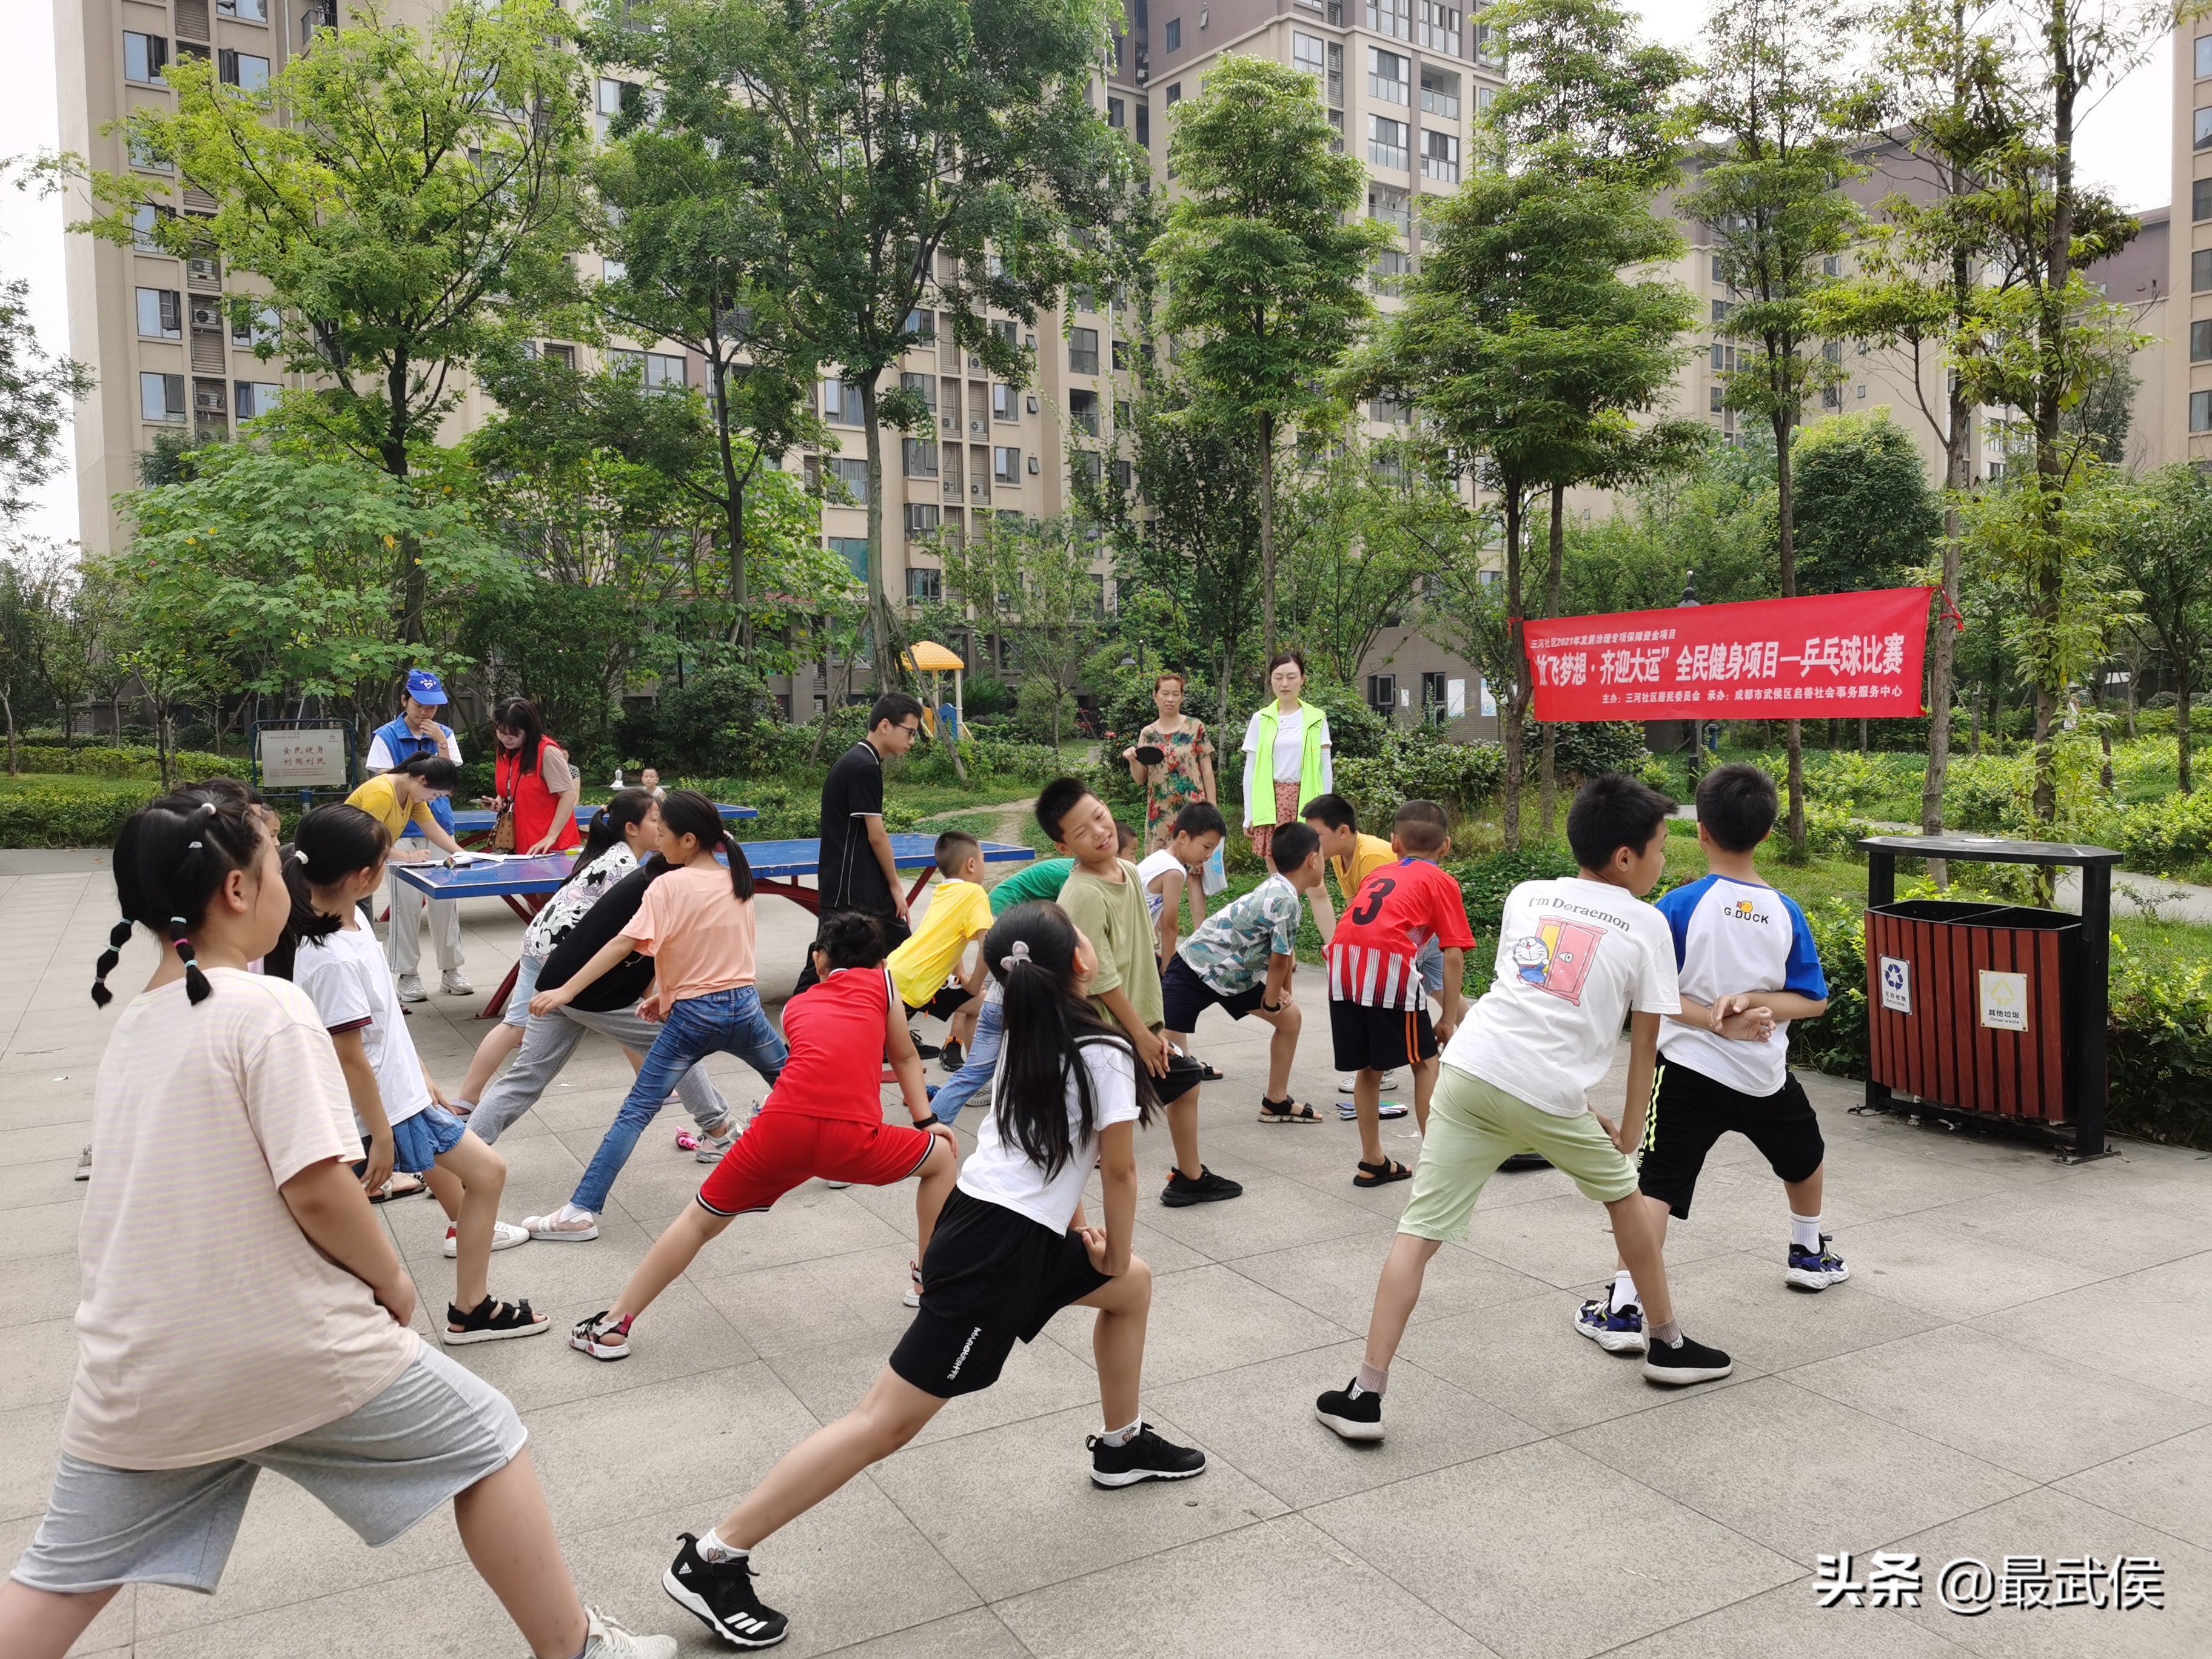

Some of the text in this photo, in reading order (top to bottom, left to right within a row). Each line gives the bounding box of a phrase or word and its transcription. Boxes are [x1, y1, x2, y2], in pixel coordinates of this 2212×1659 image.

[1530, 629, 1676, 649] 三河社区2021年发展治理专项保障资金项目
[282, 745, 323, 754] 全民健身
[1352, 878, 1396, 925] 3
[1552, 897, 1631, 933] Doraemon
[1724, 907, 1769, 925] G.DUCK
[1885, 991, 1906, 1002] 可回收物
[1988, 1009, 2020, 1019] 其他垃圾
